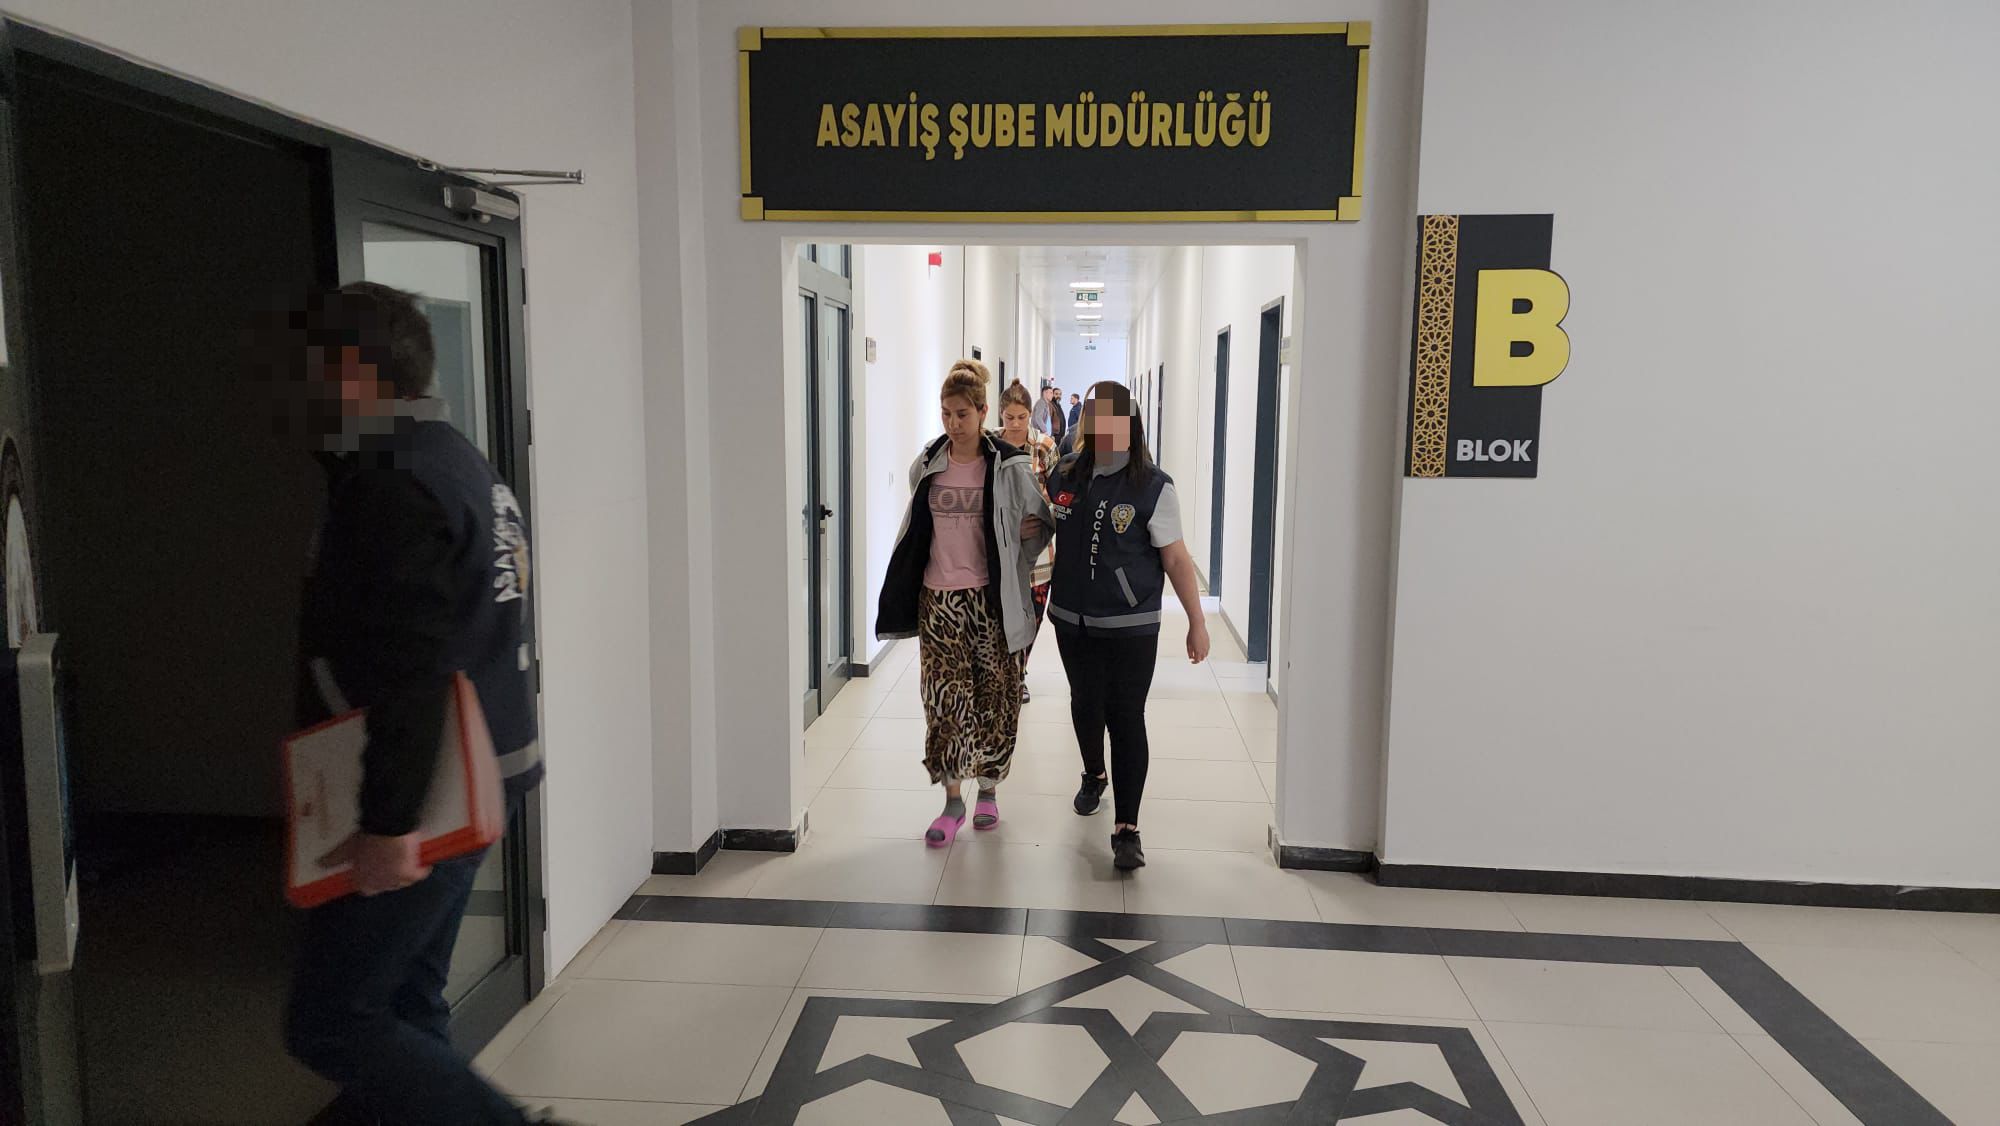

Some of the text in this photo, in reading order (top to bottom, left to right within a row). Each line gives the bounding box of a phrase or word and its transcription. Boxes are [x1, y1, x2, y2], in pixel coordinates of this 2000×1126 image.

[815, 90, 1273, 160] ASAYİŞ ŞUBE MÜDÜRLÜĞÜ
[1472, 267, 1569, 388] B
[1455, 438, 1533, 462] BLOK
